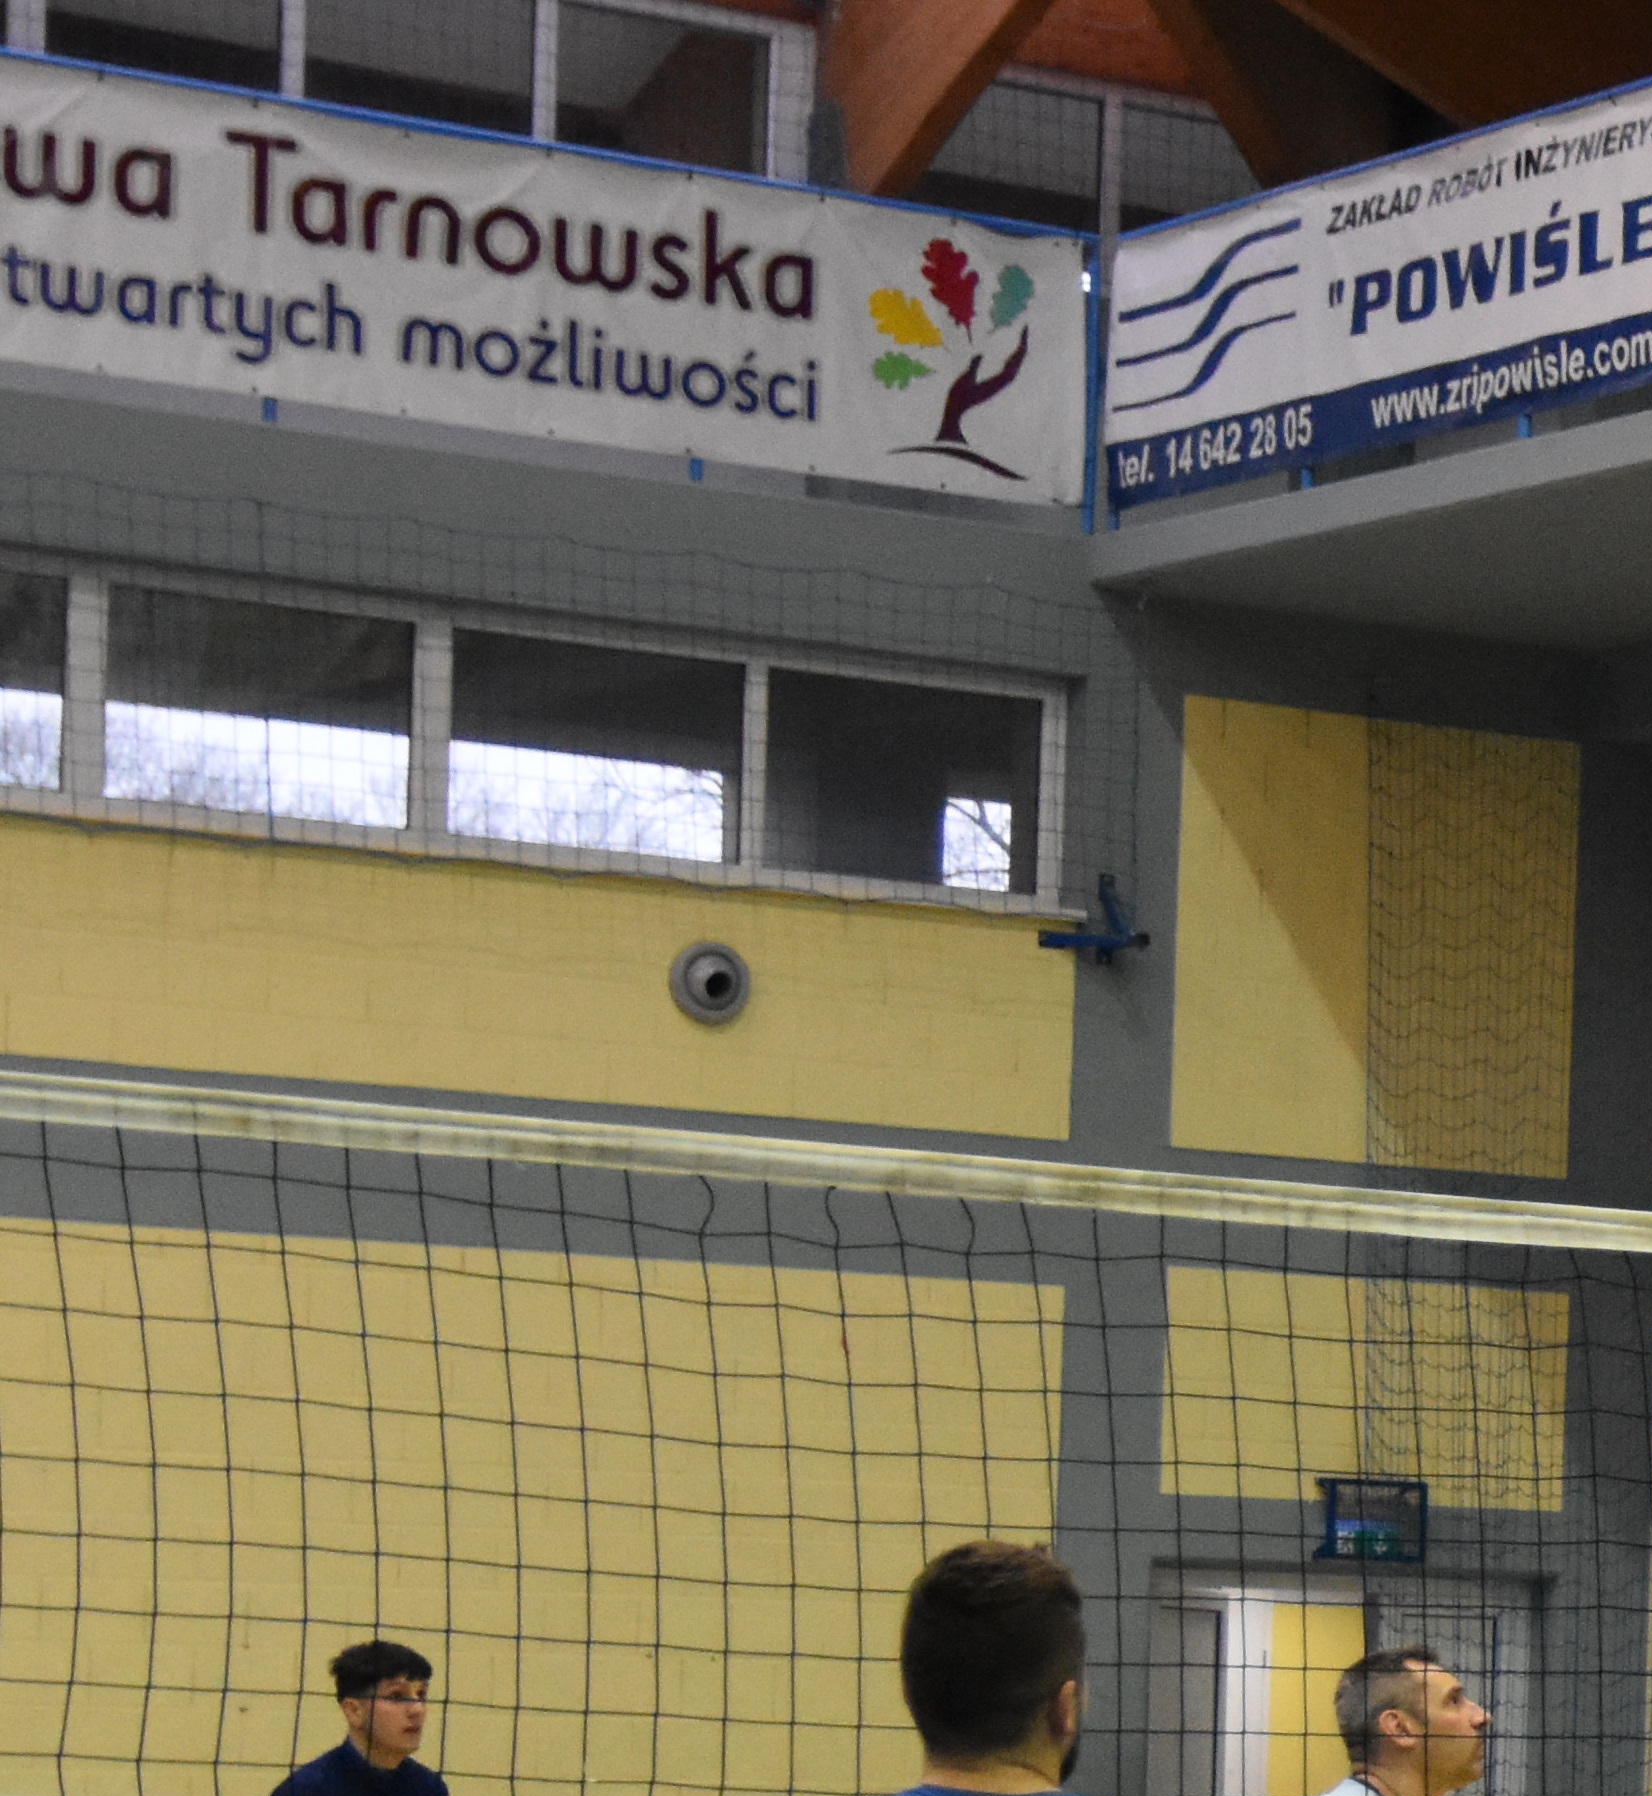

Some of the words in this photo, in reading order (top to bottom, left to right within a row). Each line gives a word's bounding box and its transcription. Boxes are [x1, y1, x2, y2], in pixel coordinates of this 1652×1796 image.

[4, 125, 172, 220] wa
[224, 130, 815, 320] Tarnowska
[1326, 185, 1422, 235] ZAKŁAD
[1428, 160, 1507, 209] ROBÓT
[0, 246, 364, 365] twartych
[402, 314, 818, 422] możliwości
[1165, 440, 1193, 477] 14
[1199, 423, 1241, 470] 642
[1249, 414, 1277, 458] 28
[1284, 406, 1313, 449] 05
